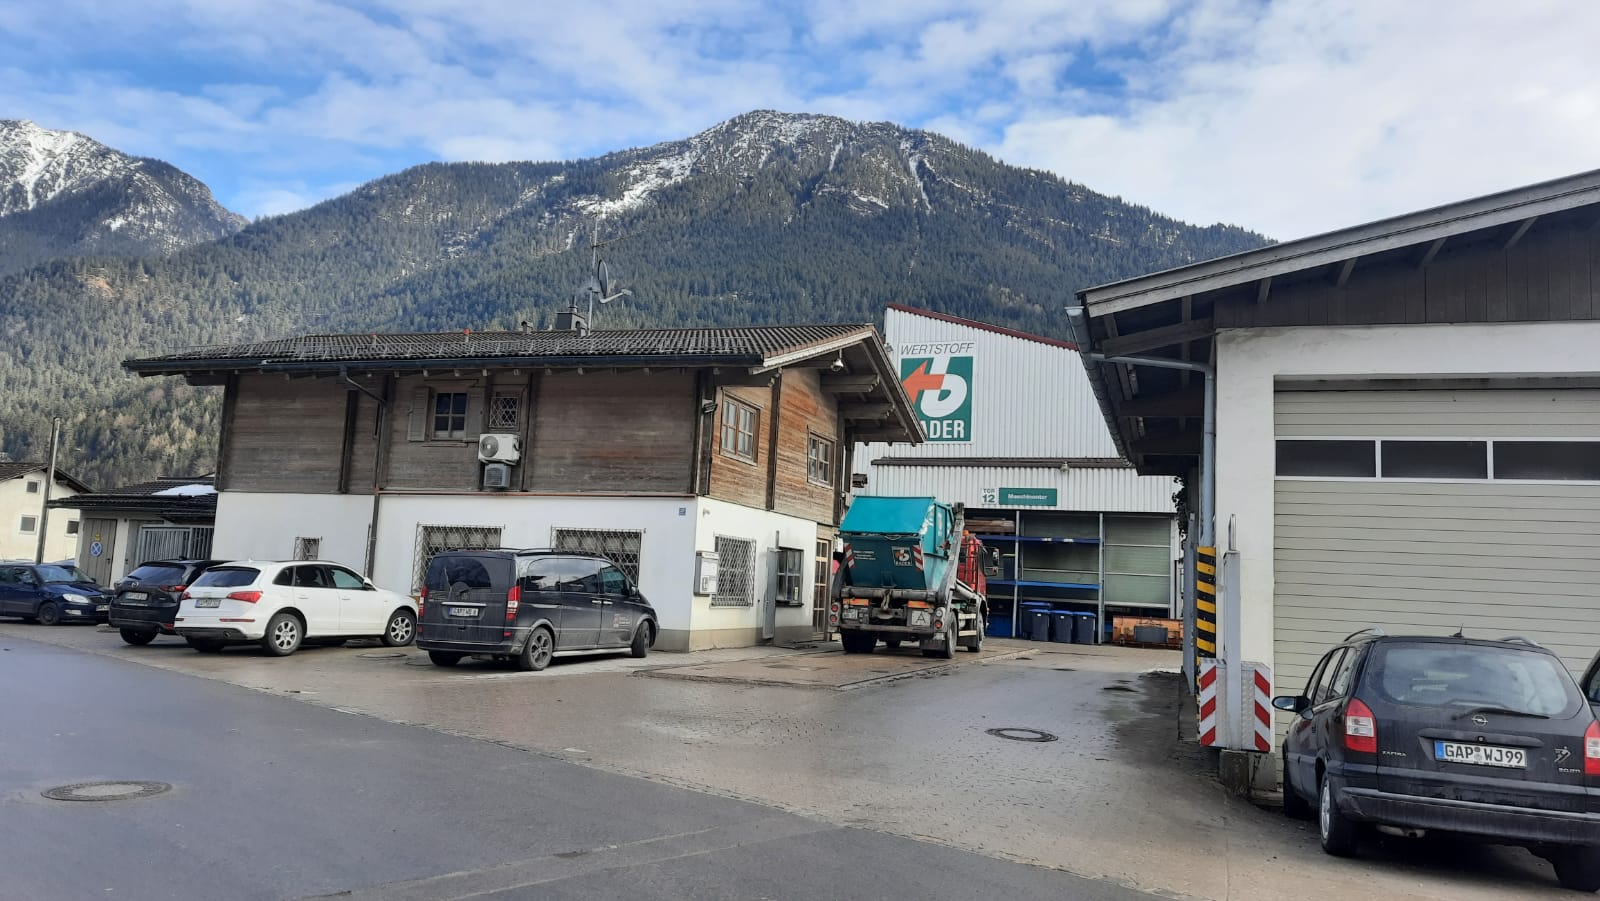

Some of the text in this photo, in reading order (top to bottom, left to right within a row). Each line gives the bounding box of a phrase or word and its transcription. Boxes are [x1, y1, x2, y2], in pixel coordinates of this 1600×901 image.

[900, 342, 975, 355] WERTSTOFF
[982, 494, 996, 503] 12
[915, 610, 926, 624] A
[1444, 744, 1474, 759] GAP
